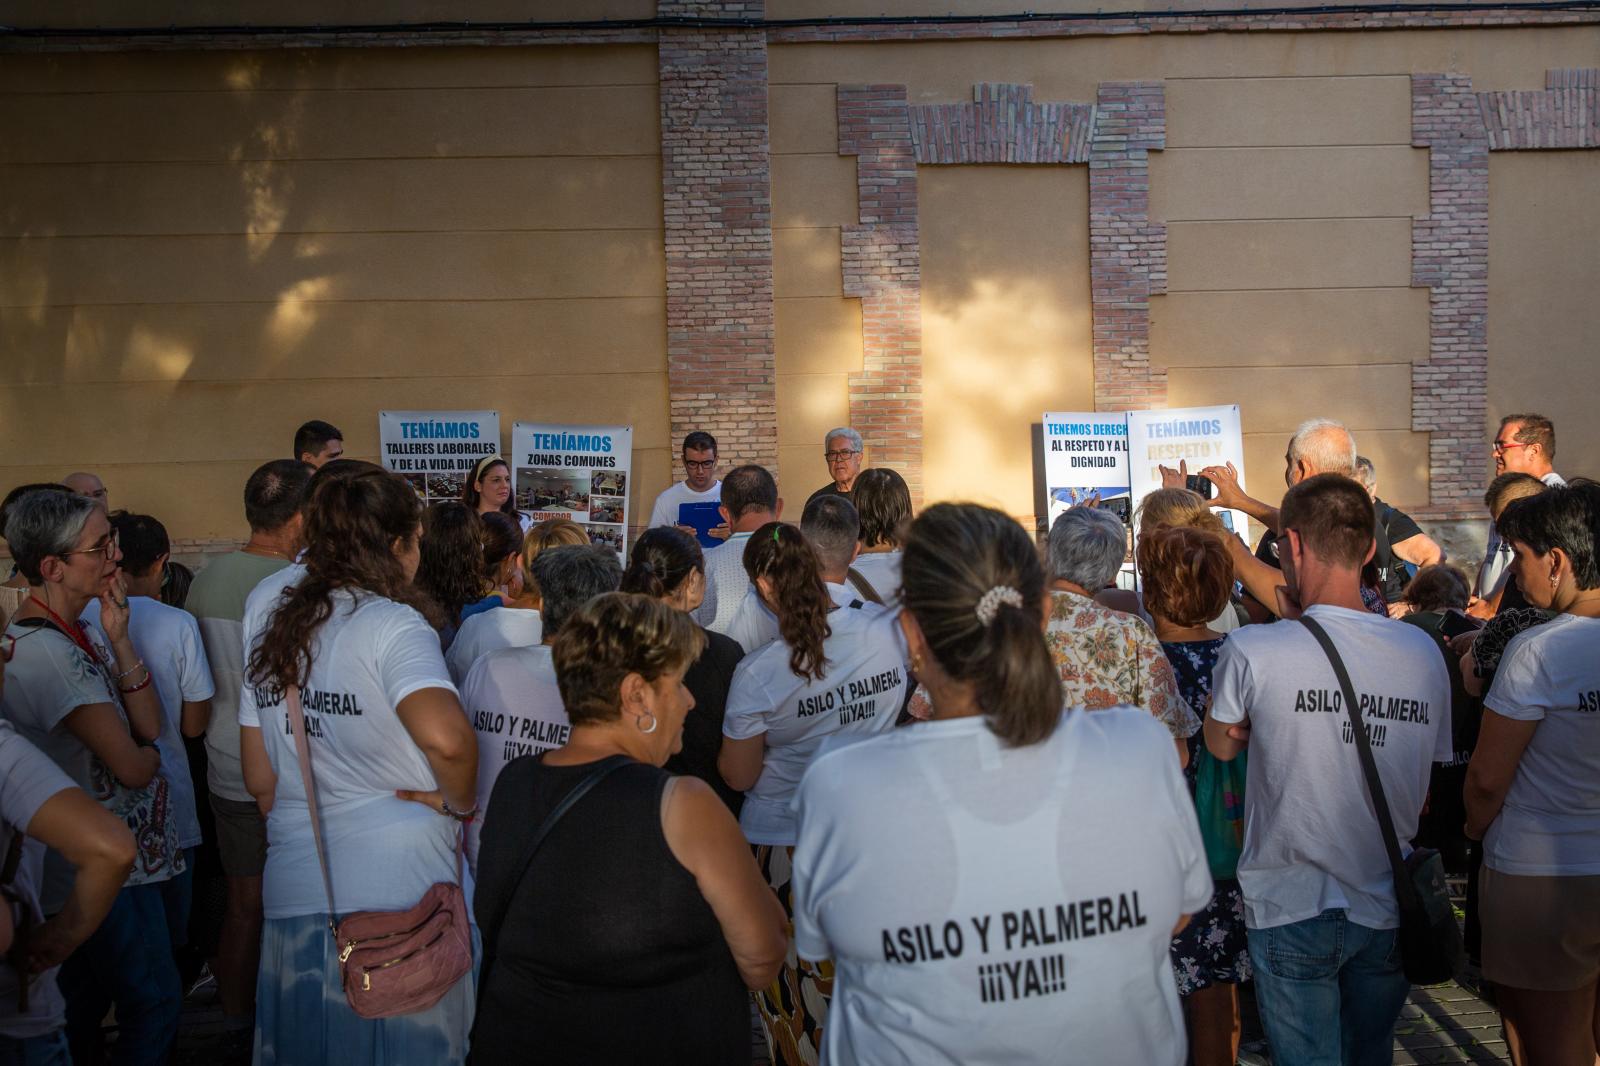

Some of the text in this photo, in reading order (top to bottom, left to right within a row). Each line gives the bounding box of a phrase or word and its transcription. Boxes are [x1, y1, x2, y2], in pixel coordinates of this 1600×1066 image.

[400, 420, 480, 439] TENÍAMOS
[1048, 423, 1091, 436] TENEMOS
[1146, 419, 1221, 439] TENÍAMOS
[386, 442, 496, 455] TALLERES LABORALES
[533, 432, 612, 452] TENÍAMOS
[1051, 440, 1063, 452] AL
[1065, 440, 1105, 452] RESPETO
[1106, 440, 1113, 452] Y
[1114, 440, 1121, 452] A
[1147, 440, 1222, 461] RESPETO Y
[390, 459, 398, 471] Y
[400, 459, 412, 470] DE
[415, 459, 428, 470] LA
[429, 459, 455, 470] VIDA
[528, 454, 616, 468] ZONAS COMUNES
[1071, 456, 1116, 468] DIGNIDAD
[797, 667, 901, 718] ASILO Y PALMERAL
[1294, 689, 1430, 725] ASILO PALMERAL
[474, 710, 570, 746] ASILO Y PALME
[881, 890, 1147, 964] ASILO Y PALMERAL
